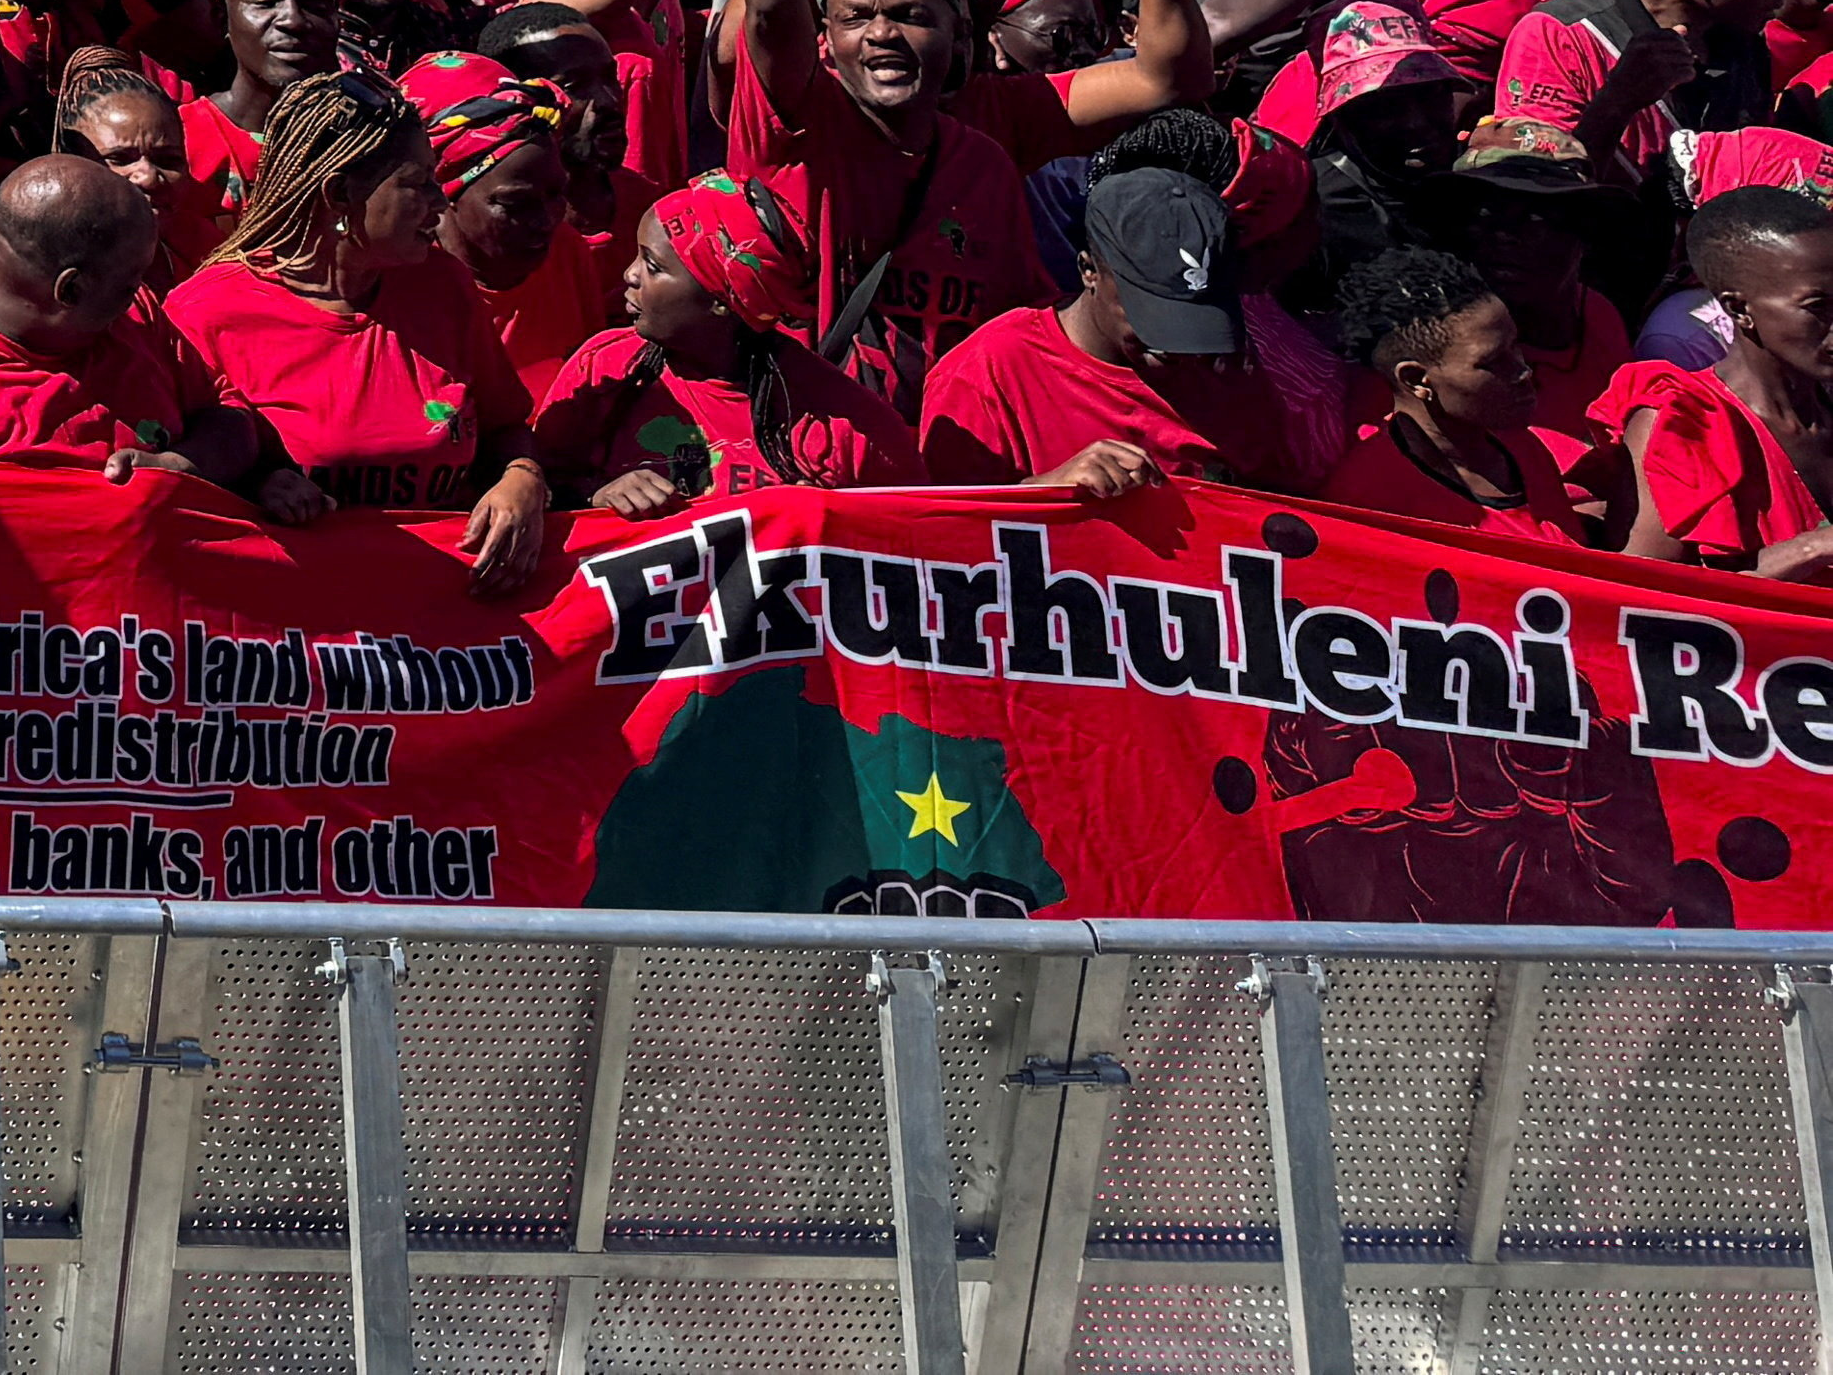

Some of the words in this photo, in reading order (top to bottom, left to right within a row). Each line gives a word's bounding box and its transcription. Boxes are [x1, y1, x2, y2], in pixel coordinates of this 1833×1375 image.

[1532, 83, 1566, 104] EFF
[184, 620, 311, 709] land
[317, 630, 536, 715] without
[581, 509, 1590, 748] Ekurhuleni
[8, 812, 216, 899] banks,
[223, 815, 323, 899] and
[332, 815, 498, 900] other
